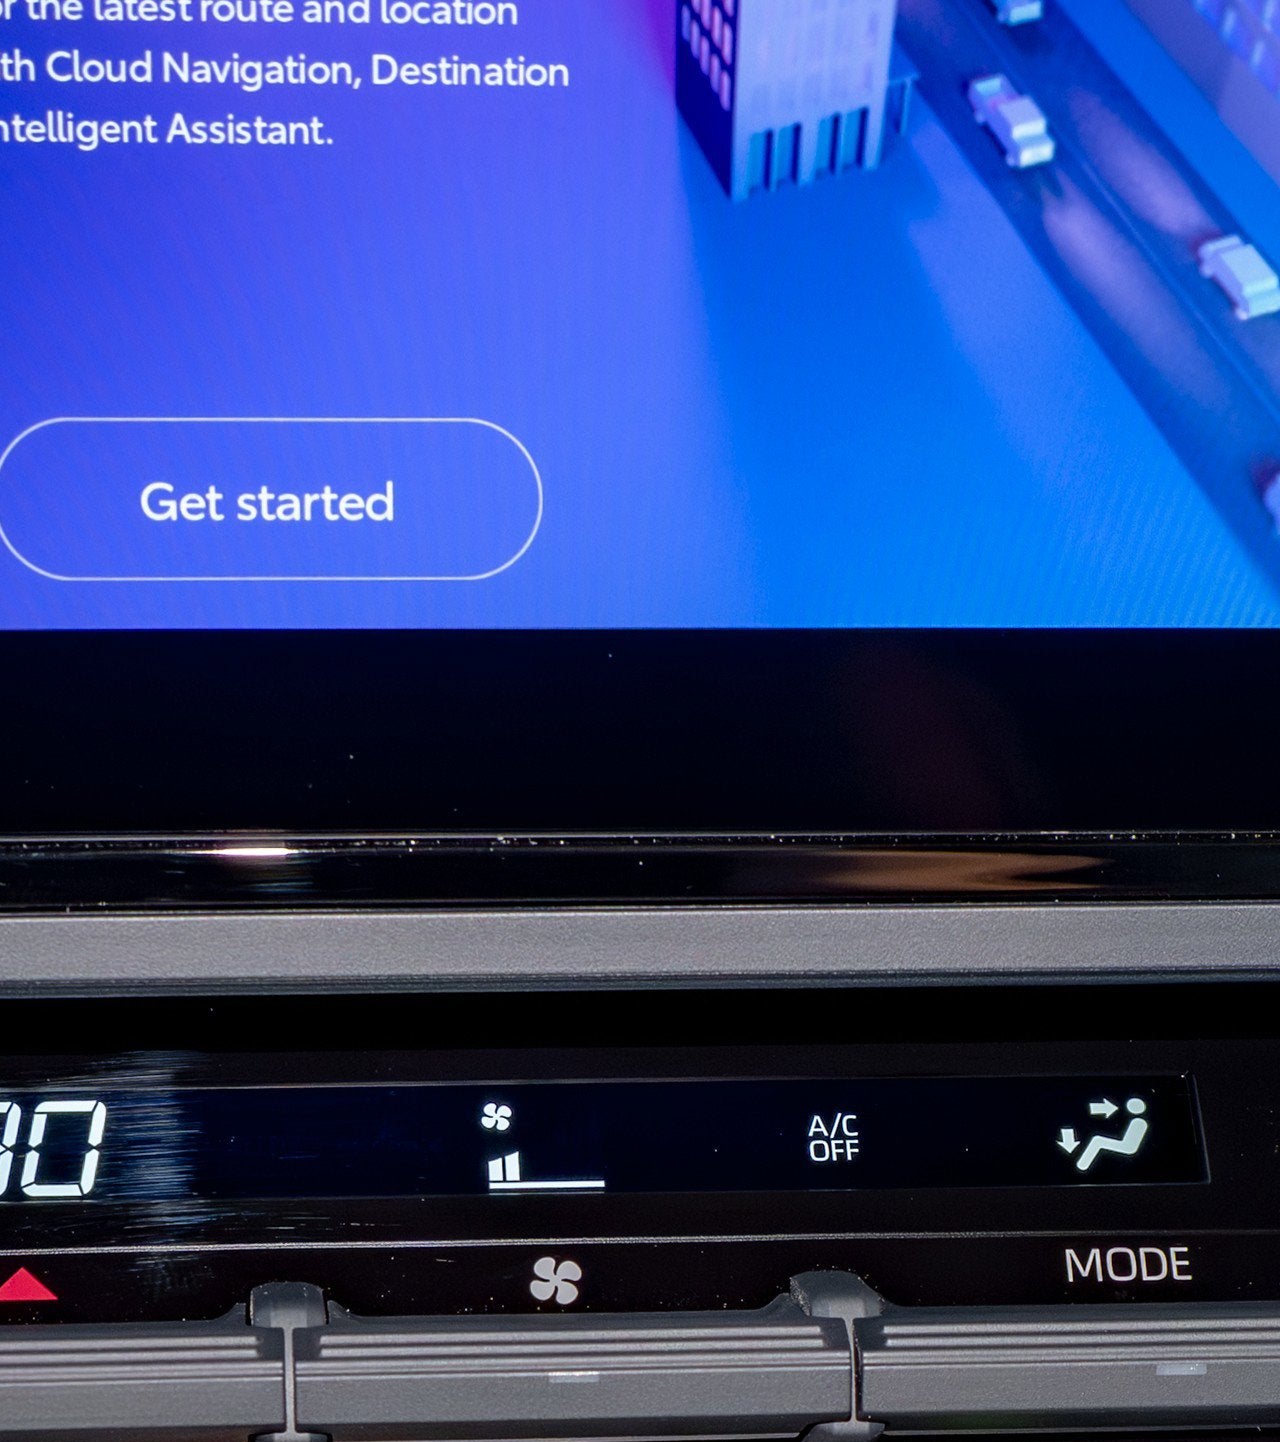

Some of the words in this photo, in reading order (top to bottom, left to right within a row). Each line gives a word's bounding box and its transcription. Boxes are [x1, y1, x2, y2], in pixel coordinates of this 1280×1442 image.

[28, 0, 83, 20] the
[94, 0, 190, 22] latest
[201, 0, 294, 23] route
[302, 0, 370, 23] and
[381, 0, 518, 25] location
[46, 49, 152, 82] Cloud
[162, 52, 362, 91] Navigation,
[371, 54, 570, 86] Destination
[166, 113, 334, 144] Assistant.
[140, 481, 225, 522] Get
[236, 480, 395, 522] started
[808, 1112, 860, 1138] A/C
[808, 1139, 861, 1163] OFF
[1064, 1246, 1194, 1284] MODE
